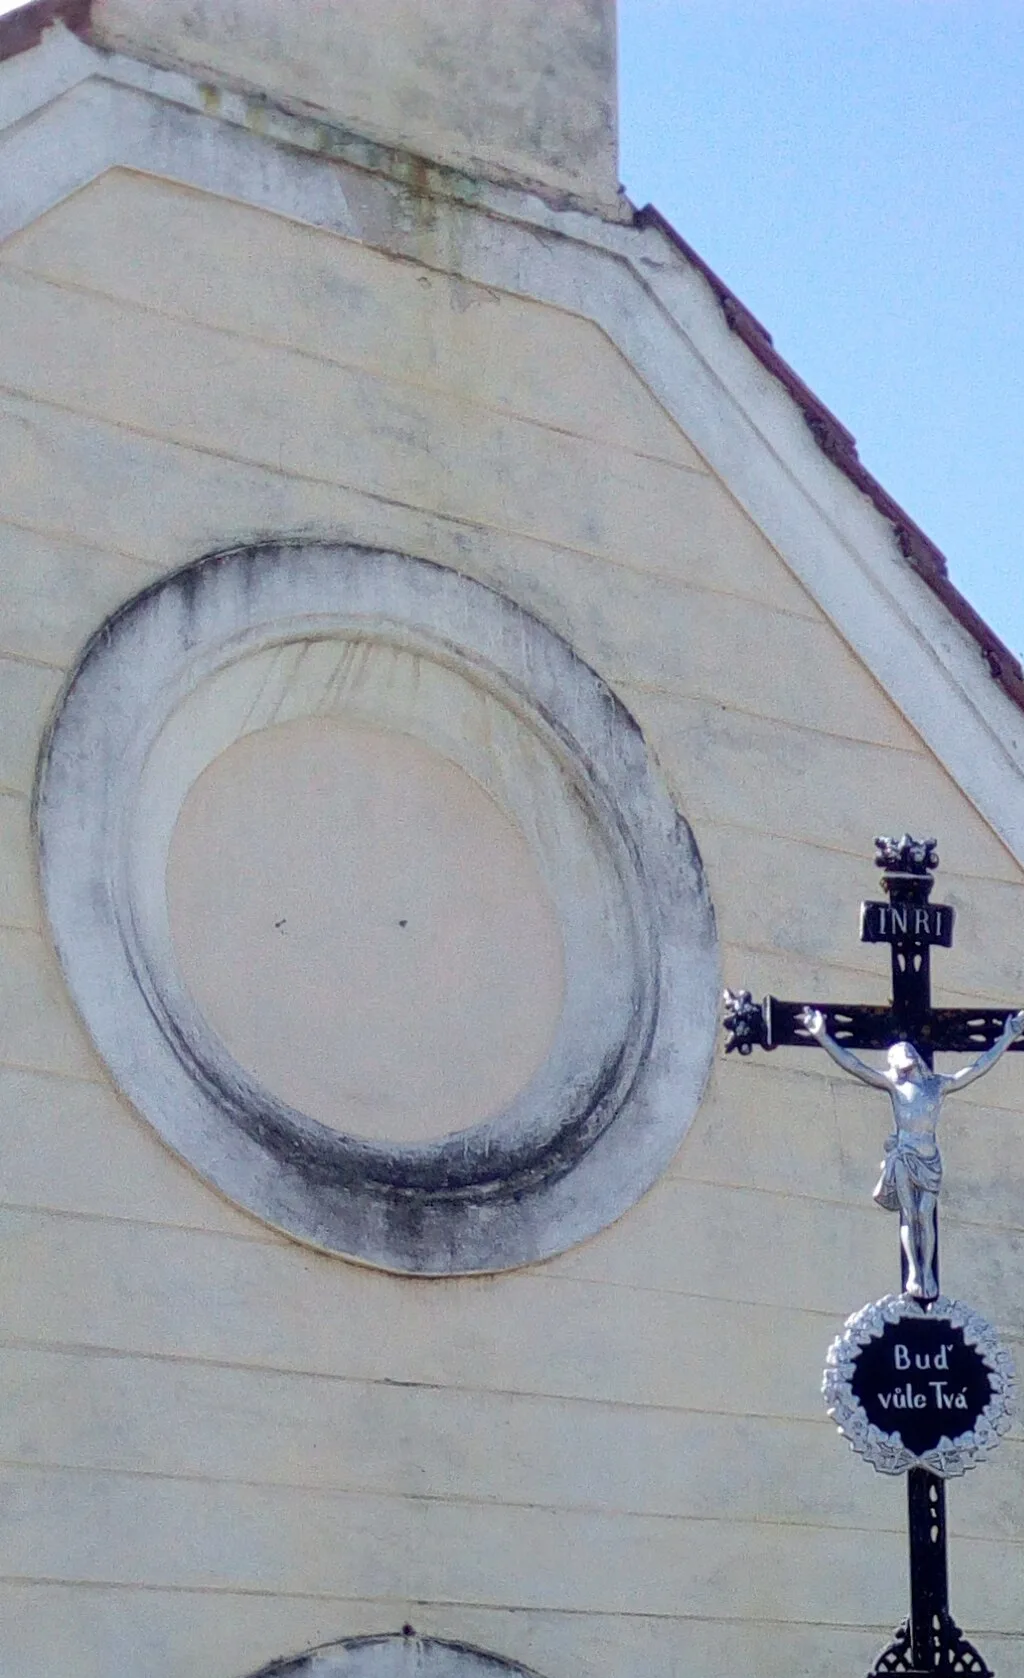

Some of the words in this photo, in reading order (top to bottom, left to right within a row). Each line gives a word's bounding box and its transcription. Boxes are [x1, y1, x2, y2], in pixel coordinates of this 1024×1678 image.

[878, 907, 943, 936] INRI
[894, 1344, 954, 1370] Buď
[877, 1383, 928, 1410] vůle
[928, 1381, 968, 1409] Tvá
